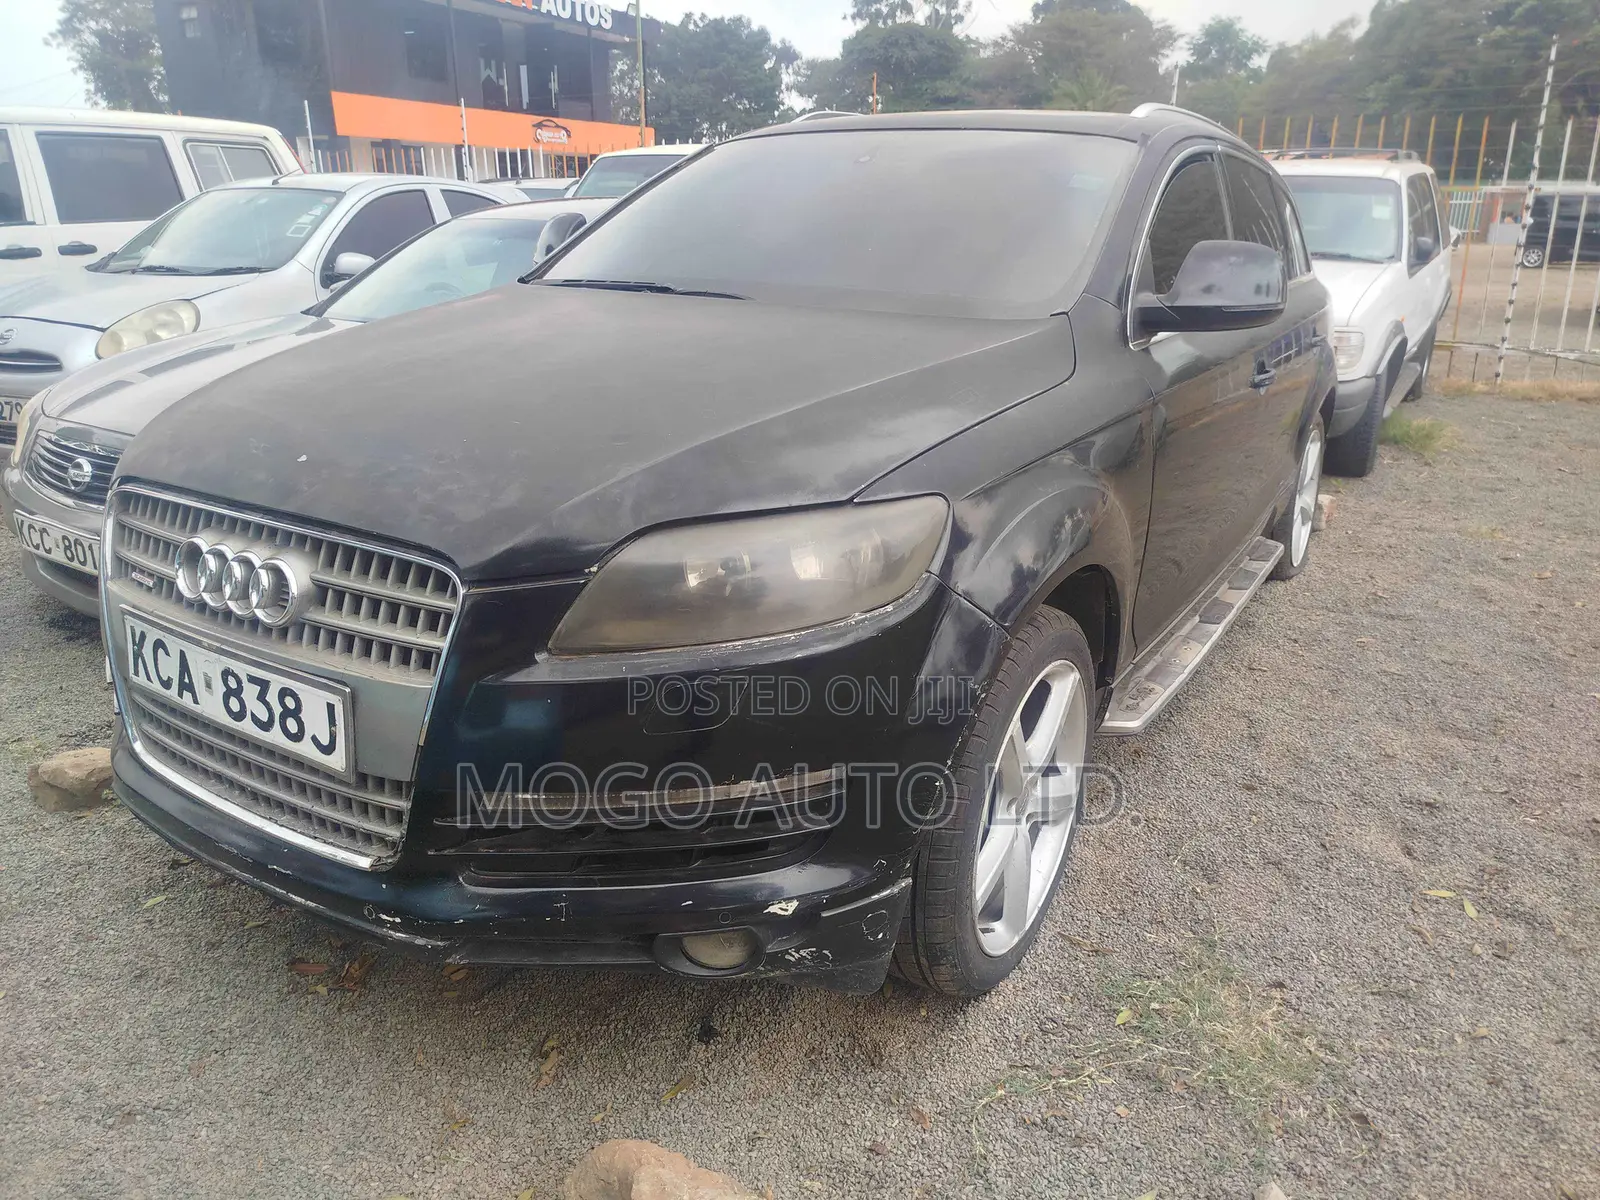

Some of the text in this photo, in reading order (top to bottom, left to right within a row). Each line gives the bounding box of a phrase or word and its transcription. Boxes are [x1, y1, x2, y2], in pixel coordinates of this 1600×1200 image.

[540, 0, 613, 30] AUTOS
[16, 518, 52, 555] KCC
[129, 625, 338, 757] KCA 838J
